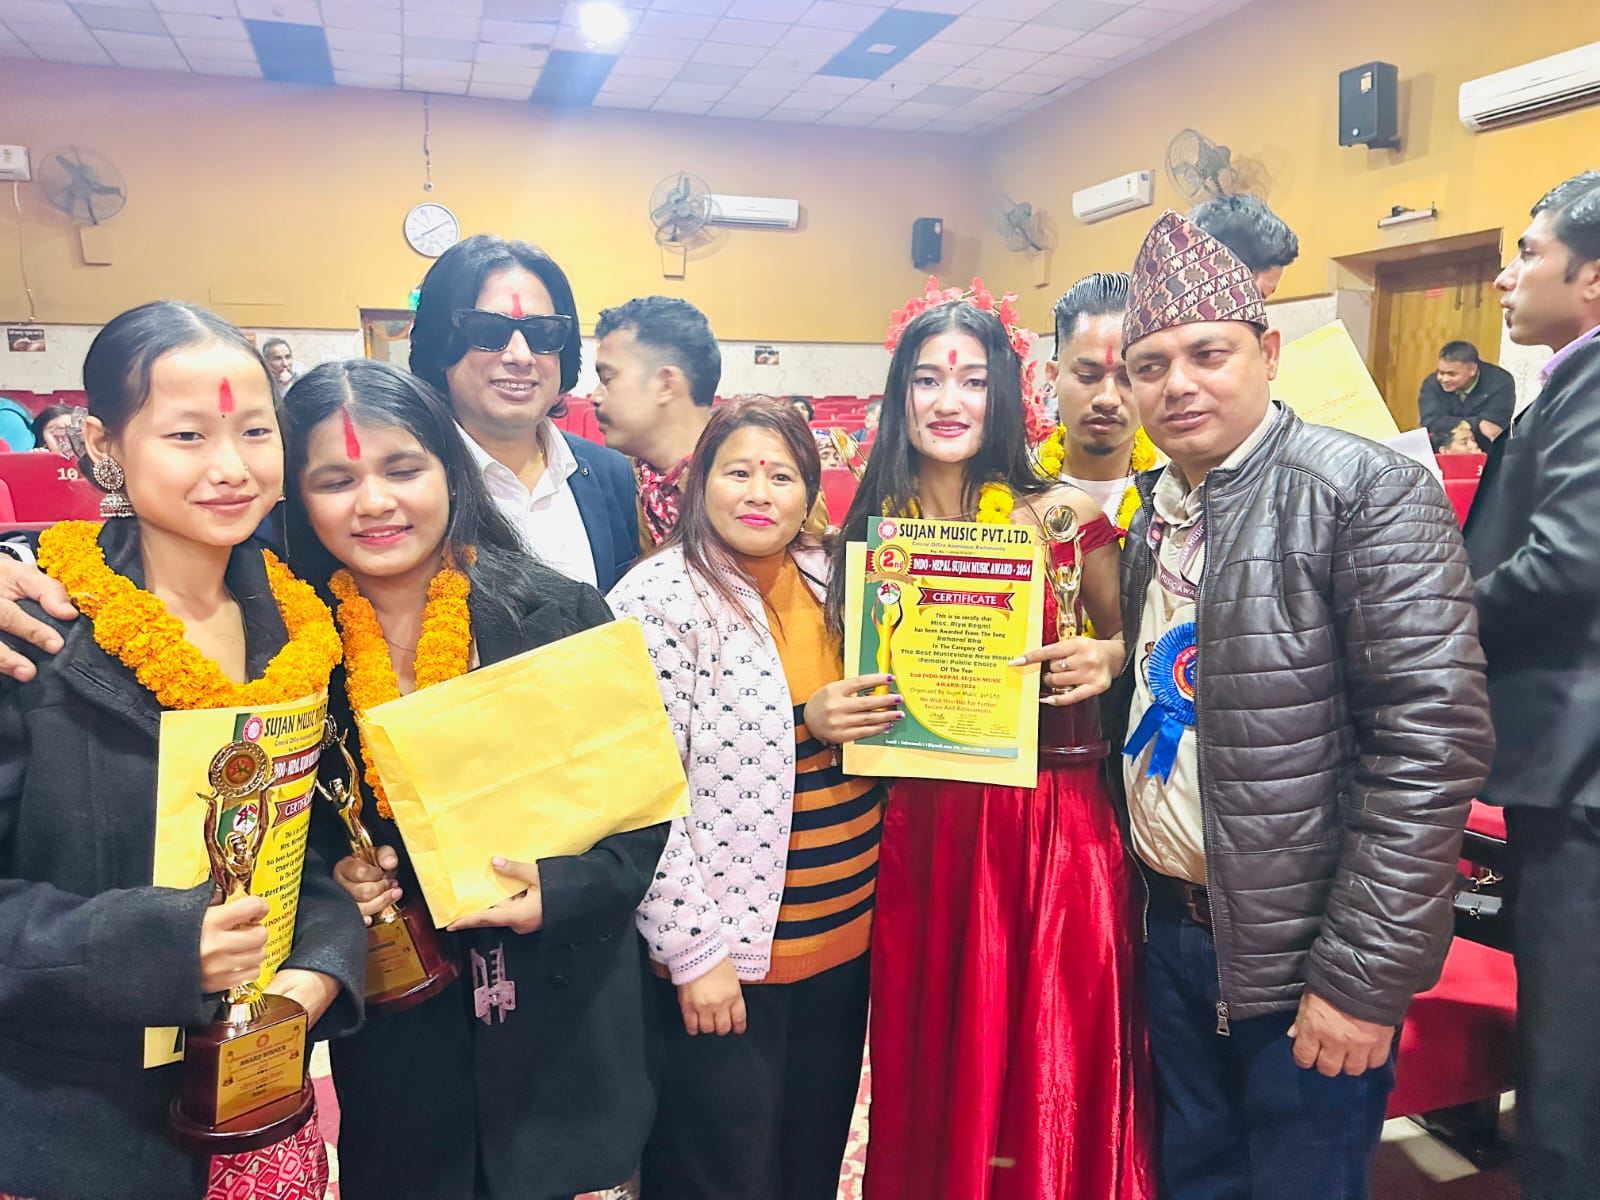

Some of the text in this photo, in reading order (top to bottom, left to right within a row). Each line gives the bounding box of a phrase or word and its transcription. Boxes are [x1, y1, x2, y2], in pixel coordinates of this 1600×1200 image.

[899, 523, 936, 540] SUJAN
[940, 526, 978, 541] MUSIC
[981, 528, 1032, 544] PVT.LTD.
[883, 551, 904, 568] 2nd
[913, 558, 929, 570] INDO
[932, 559, 951, 572] NEPAL
[952, 560, 971, 575] SUJAN
[972, 561, 990, 574] MUSIC
[990, 562, 1013, 575] AWARD
[1160, 572, 1195, 595] MUSIC AWA
[932, 592, 998, 605] CERTIFICATE
[264, 714, 295, 738] SUJAN
[296, 709, 315, 731] MUSIC
